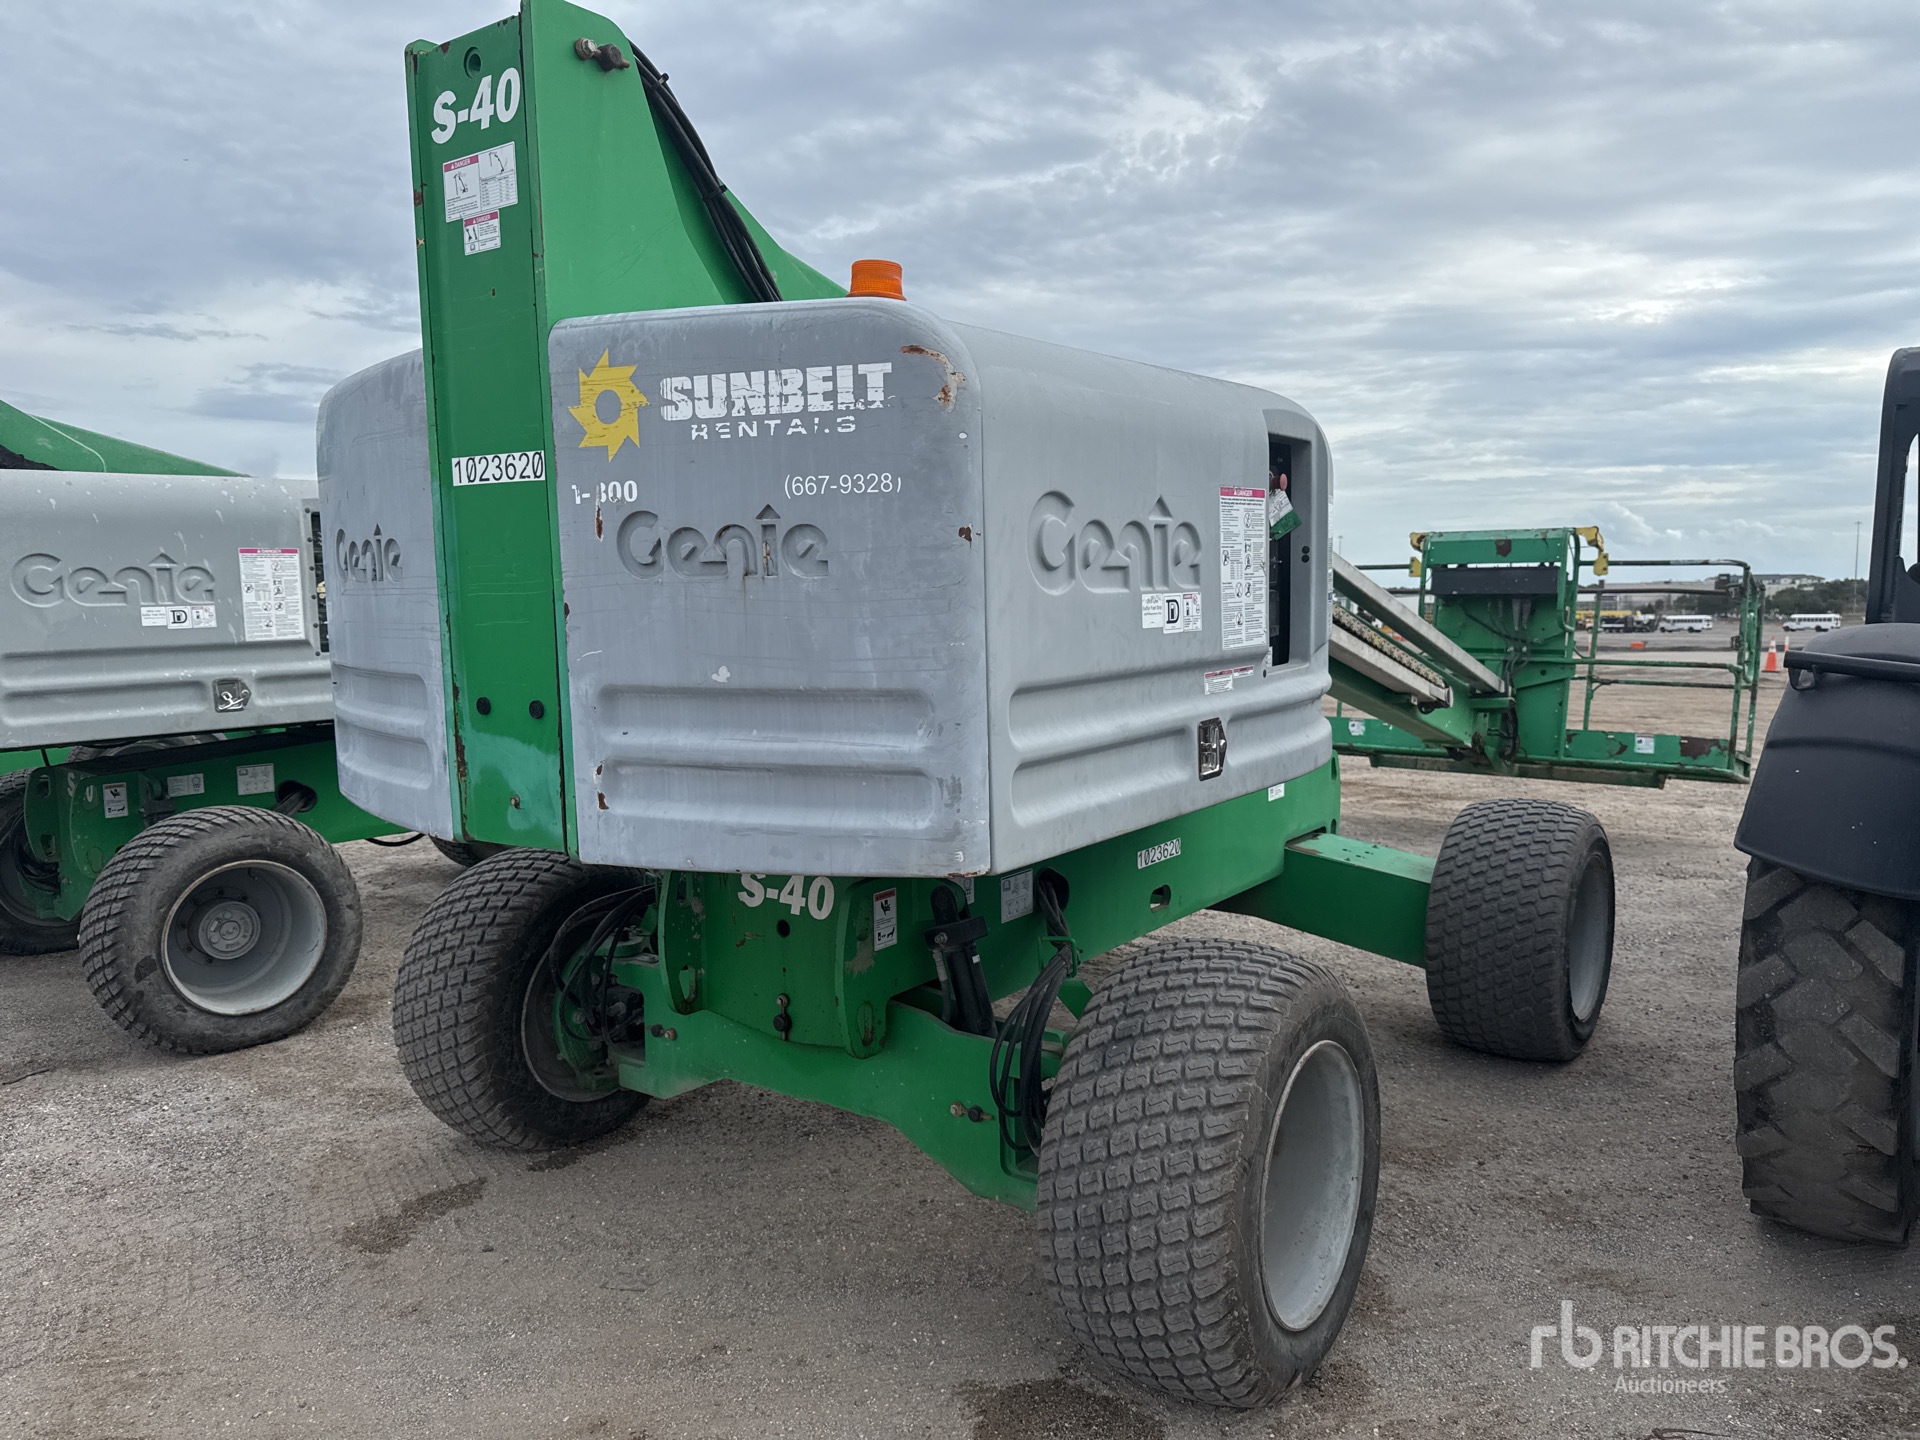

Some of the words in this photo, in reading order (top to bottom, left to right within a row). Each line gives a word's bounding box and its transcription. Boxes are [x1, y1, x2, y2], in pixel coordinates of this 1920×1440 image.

[431, 67, 521, 145] S-40
[660, 362, 892, 421] SUNBELT
[454, 451, 544, 484] 1023620
[784, 472, 902, 499] (667-9328)
[336, 523, 404, 583] Genie
[616, 504, 829, 580] Genie
[1027, 490, 1202, 596] Genie
[10, 553, 216, 608] Genie
[1138, 838, 1181, 868] 1023620
[737, 873, 835, 920] S-40
